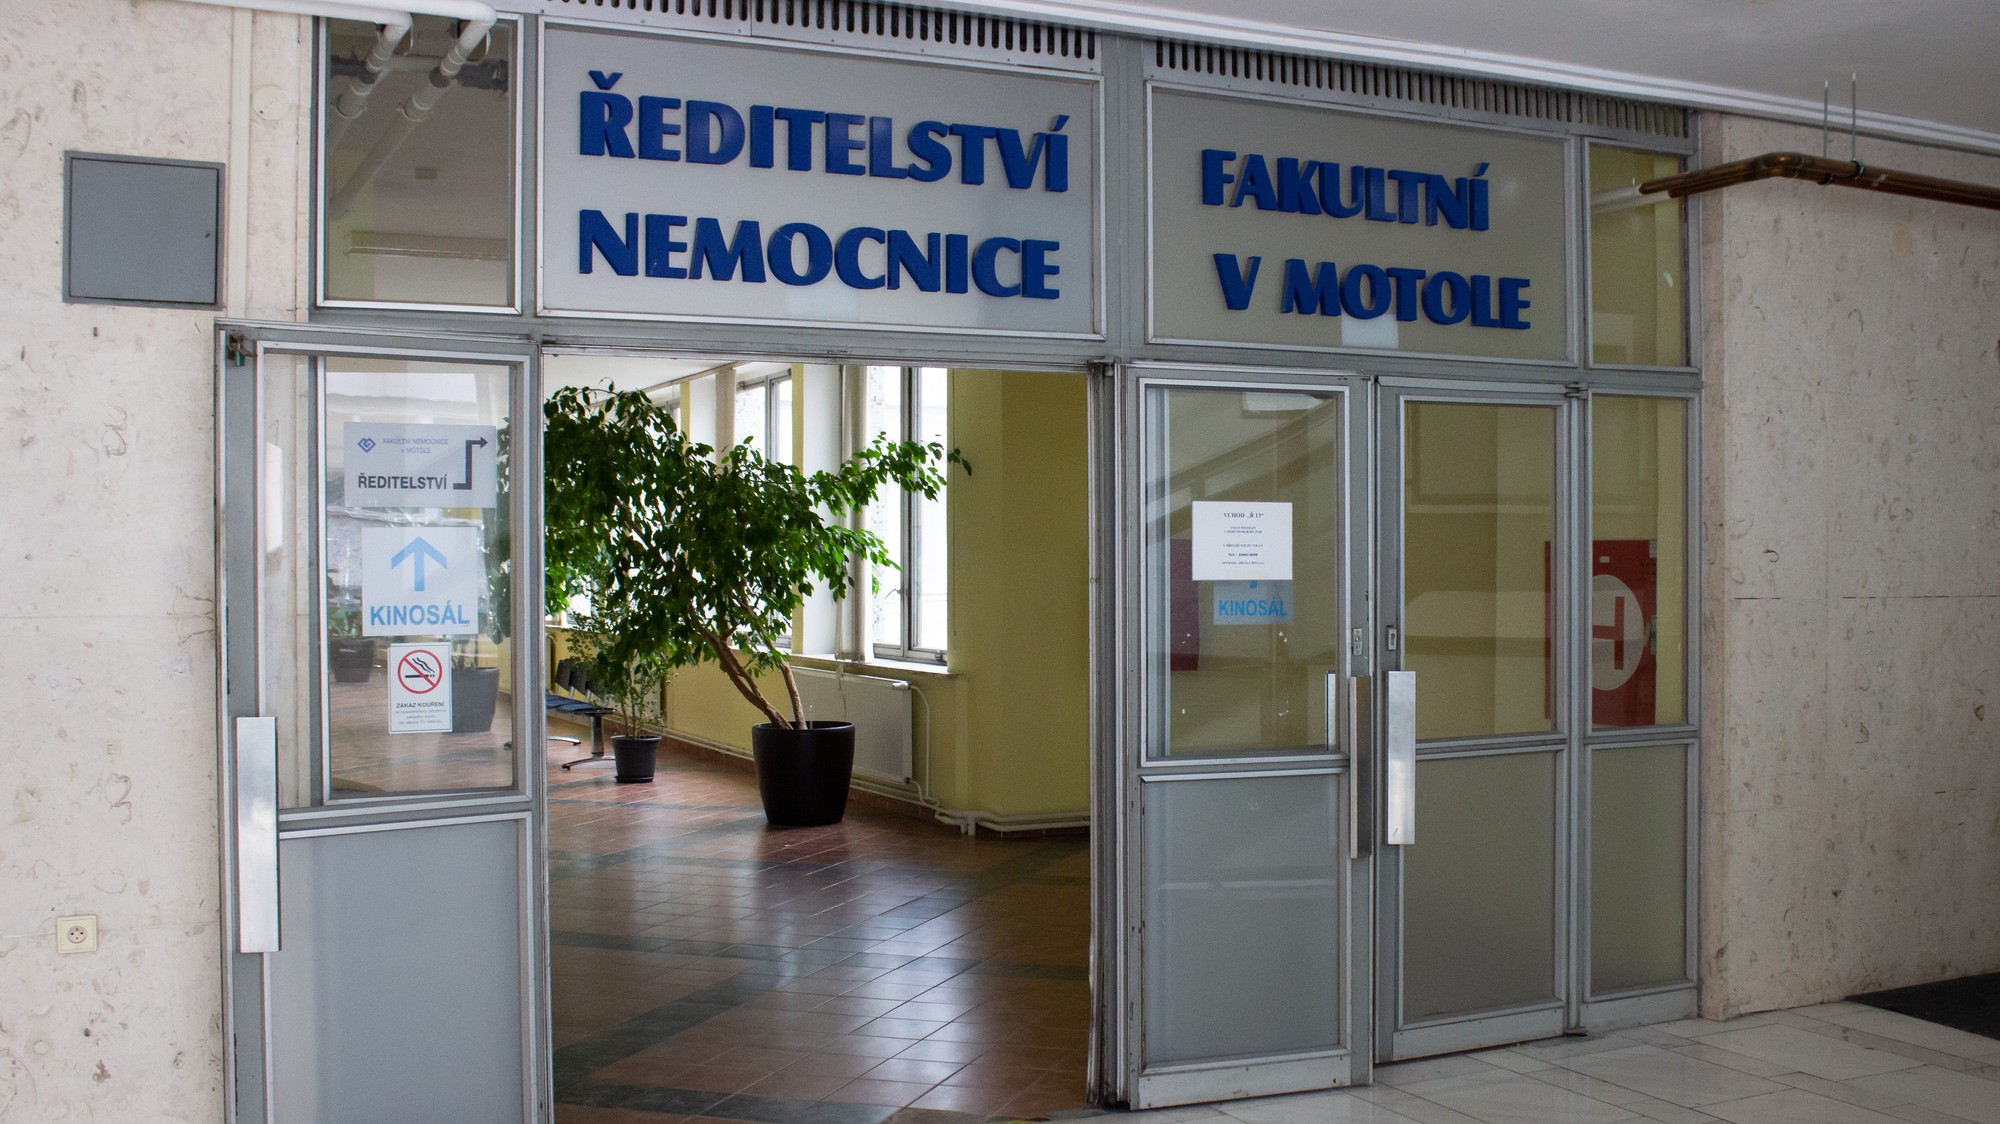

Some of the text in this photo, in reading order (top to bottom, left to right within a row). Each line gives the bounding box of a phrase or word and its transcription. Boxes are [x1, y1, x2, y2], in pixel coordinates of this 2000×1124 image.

[579, 69, 1071, 193] ŘEDITELSTVÍ
[1201, 148, 1490, 231] FAKULTNÍ
[579, 209, 1060, 299] NEMOCNICE
[1213, 252, 1531, 330] V MOTOLE
[412, 438, 449, 446] NEMOCNICE
[358, 472, 448, 490] ŘEDITELSTVÍ
[370, 600, 470, 626] KINOSÁL
[1218, 596, 1288, 617] KINOSÁL
